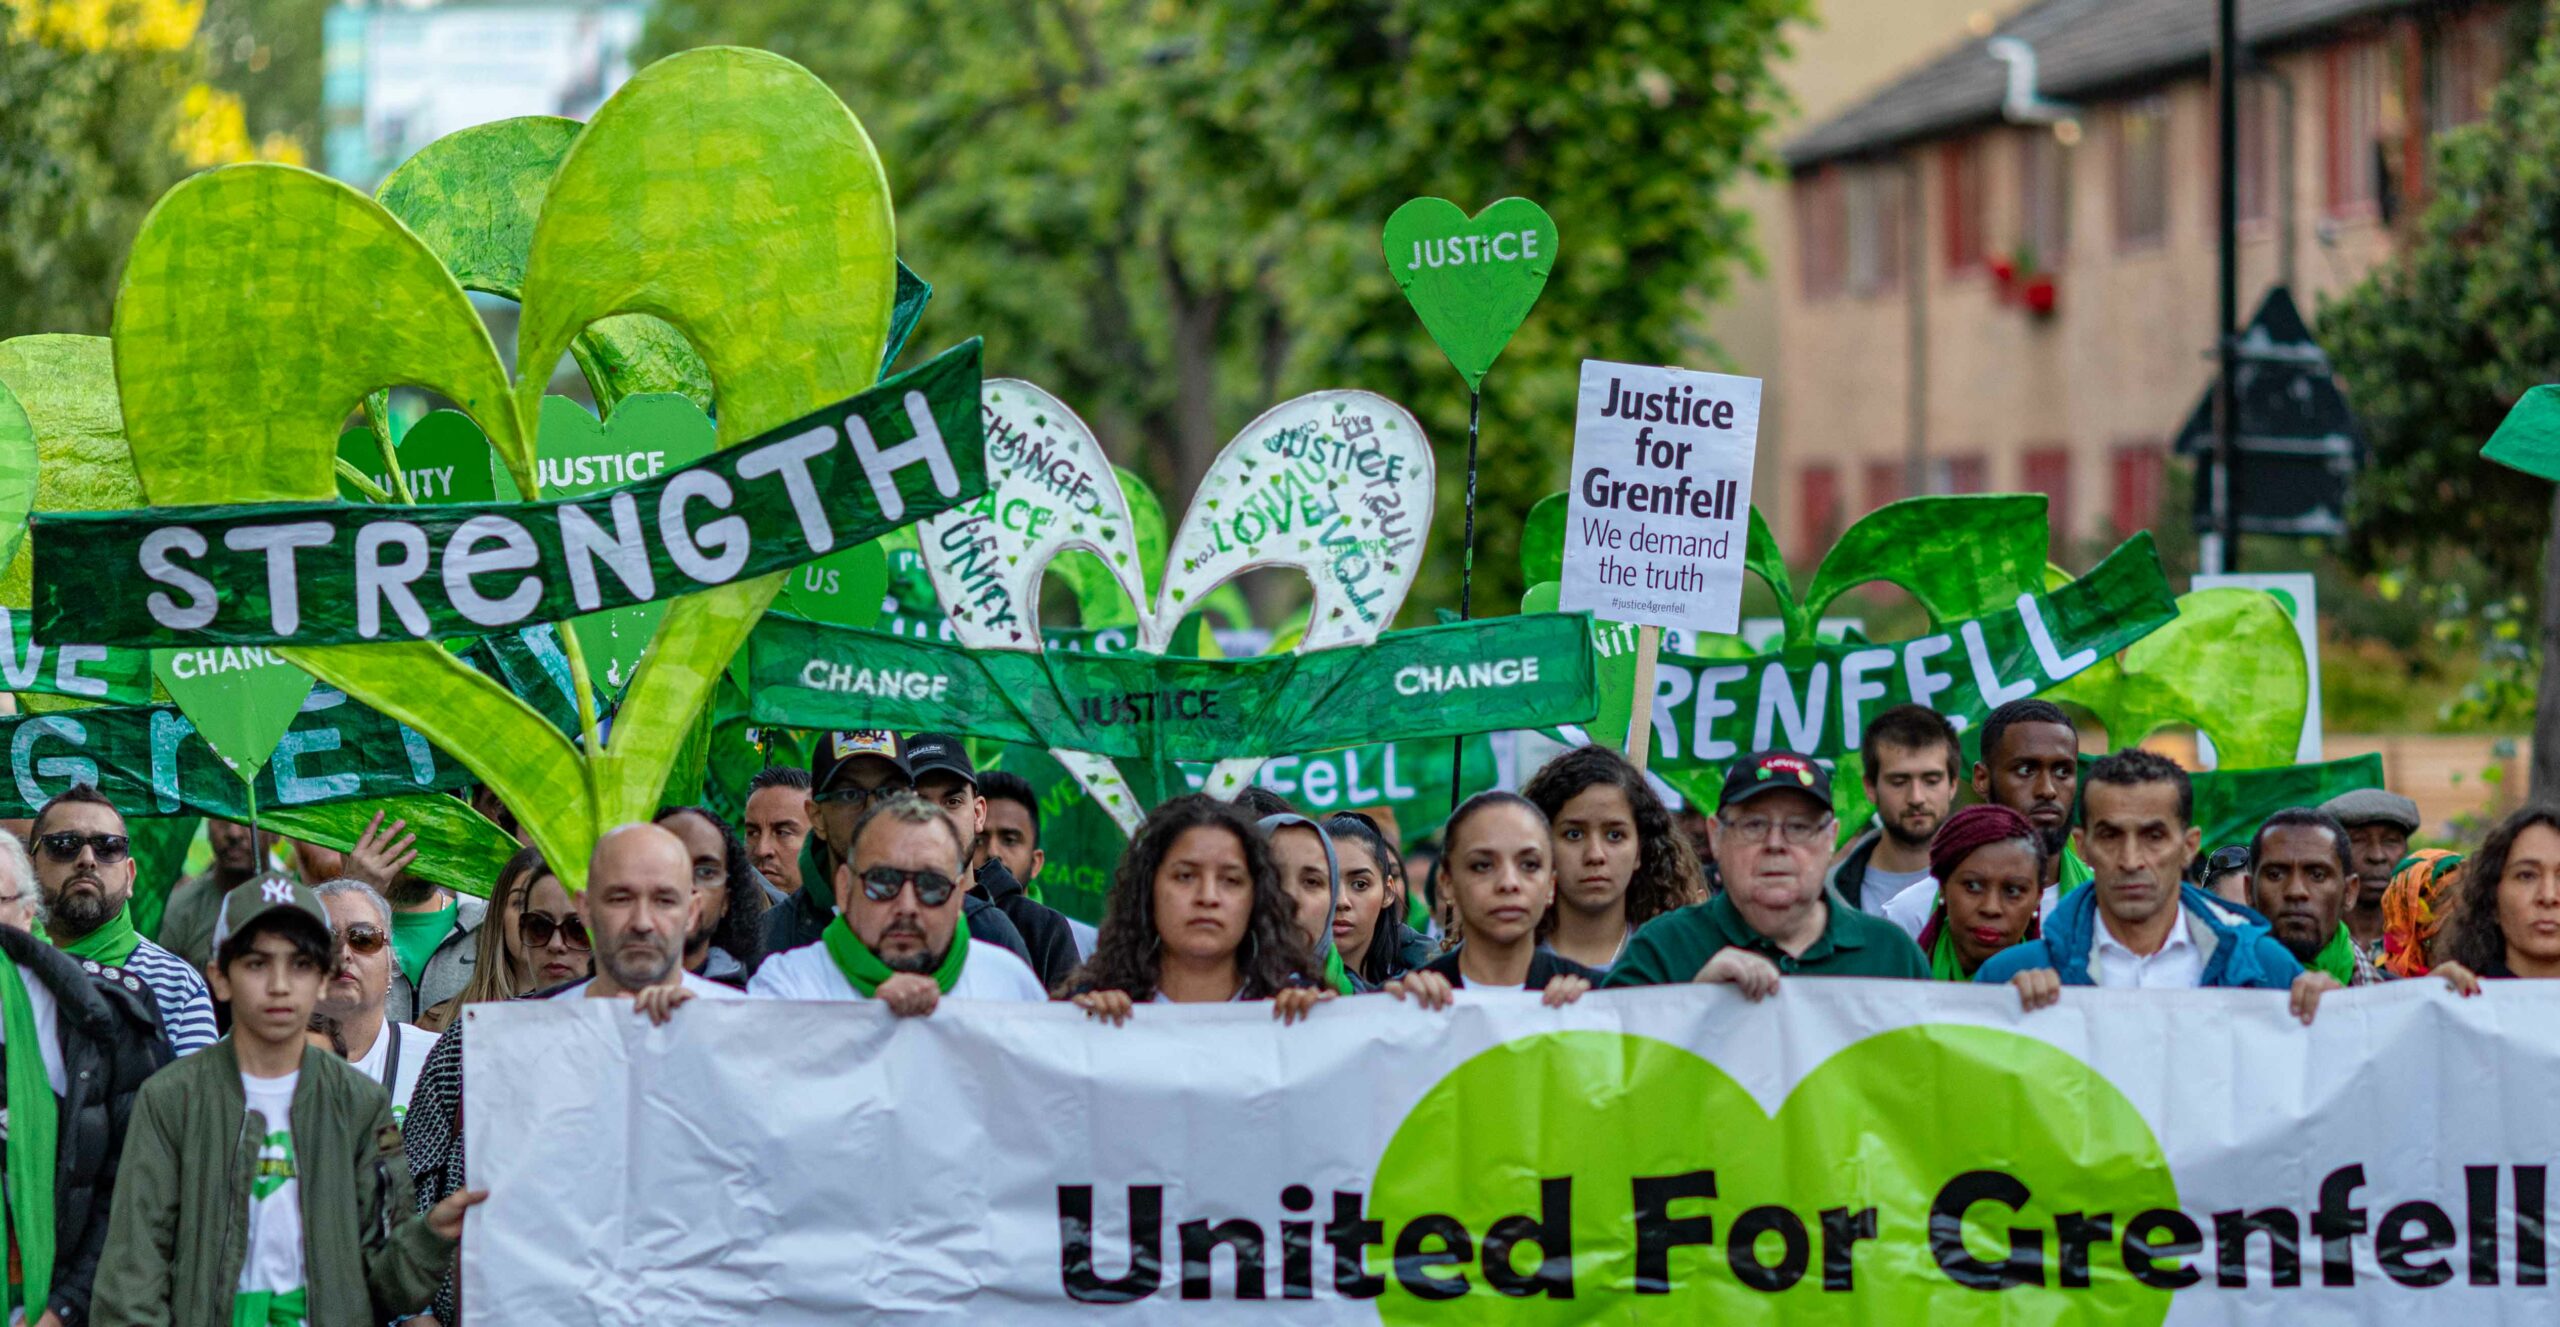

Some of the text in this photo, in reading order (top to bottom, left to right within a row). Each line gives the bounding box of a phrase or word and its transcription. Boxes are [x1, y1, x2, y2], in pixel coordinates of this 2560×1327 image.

[1600, 377, 1734, 430] Justice
[538, 450, 665, 488] JUSTICE
[1635, 427, 1692, 470] for
[1582, 467, 1737, 520] Grenfell
[1583, 517, 1729, 560] We demand
[804, 565, 841, 595] US
[1599, 555, 1704, 594] the truth
[1611, 597, 1686, 614] #justice4grenfell
[802, 659, 949, 702] CHANGE
[1393, 656, 1540, 697] CHANGE
[1624, 592, 2098, 760] RENFELL
[1077, 689, 1221, 727] JUSTICE
[1057, 1163, 2548, 1304] United For Grenfell
